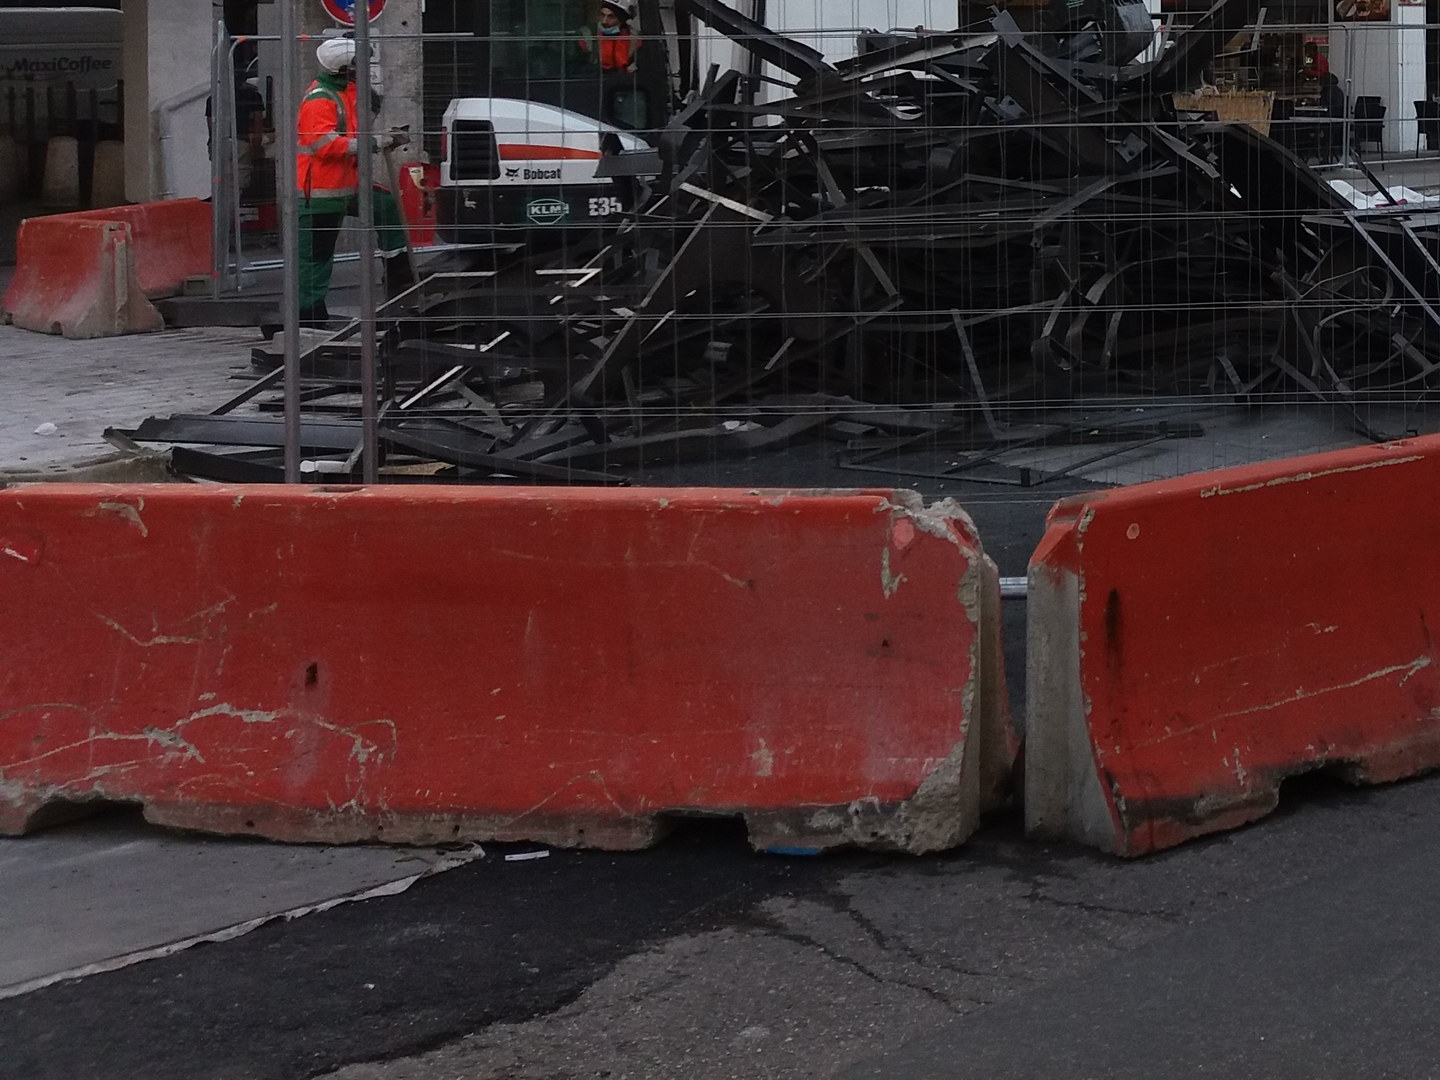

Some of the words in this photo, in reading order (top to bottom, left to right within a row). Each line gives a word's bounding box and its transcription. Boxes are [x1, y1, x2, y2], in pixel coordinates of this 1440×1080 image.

[8, 56, 112, 73] MaxiCoffee
[523, 168, 562, 180] Bobcat
[588, 197, 623, 217] E35
